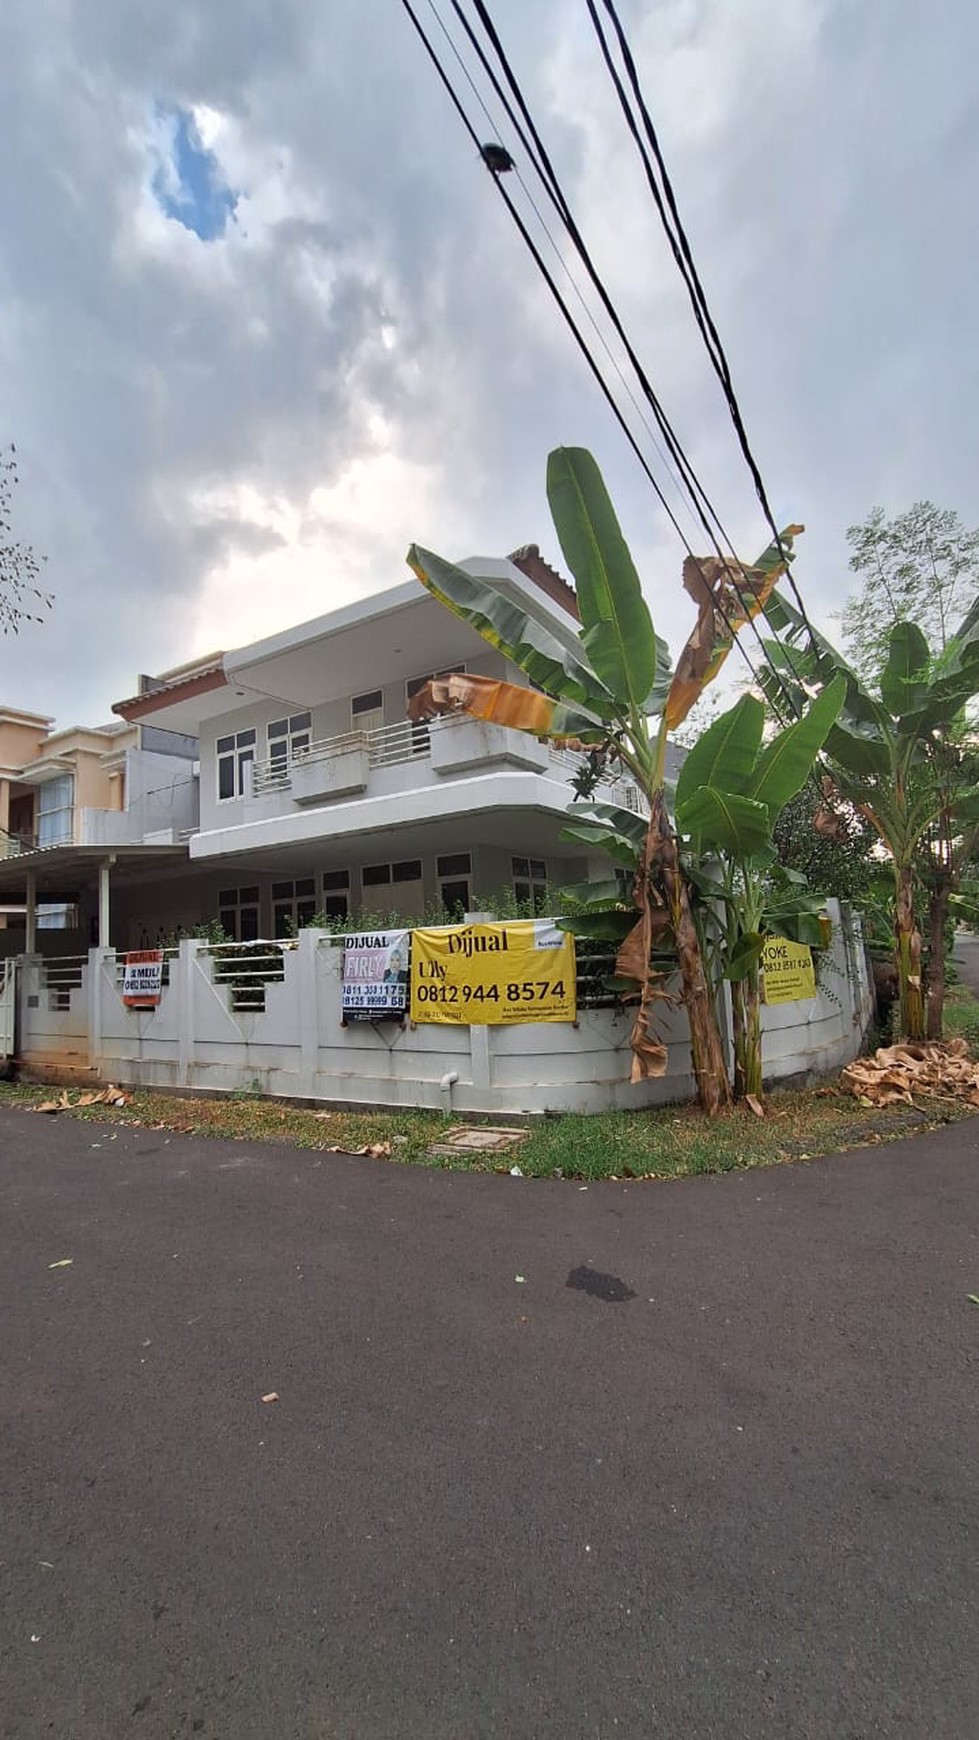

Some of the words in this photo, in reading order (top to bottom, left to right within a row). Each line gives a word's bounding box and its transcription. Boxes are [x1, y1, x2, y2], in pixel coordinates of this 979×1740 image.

[346, 936, 389, 949] DIJUAL
[448, 929, 509, 957] Dijual
[417, 985, 458, 1002] 0812
[462, 984, 500, 1002] 944
[506, 980, 566, 1001] 8574
